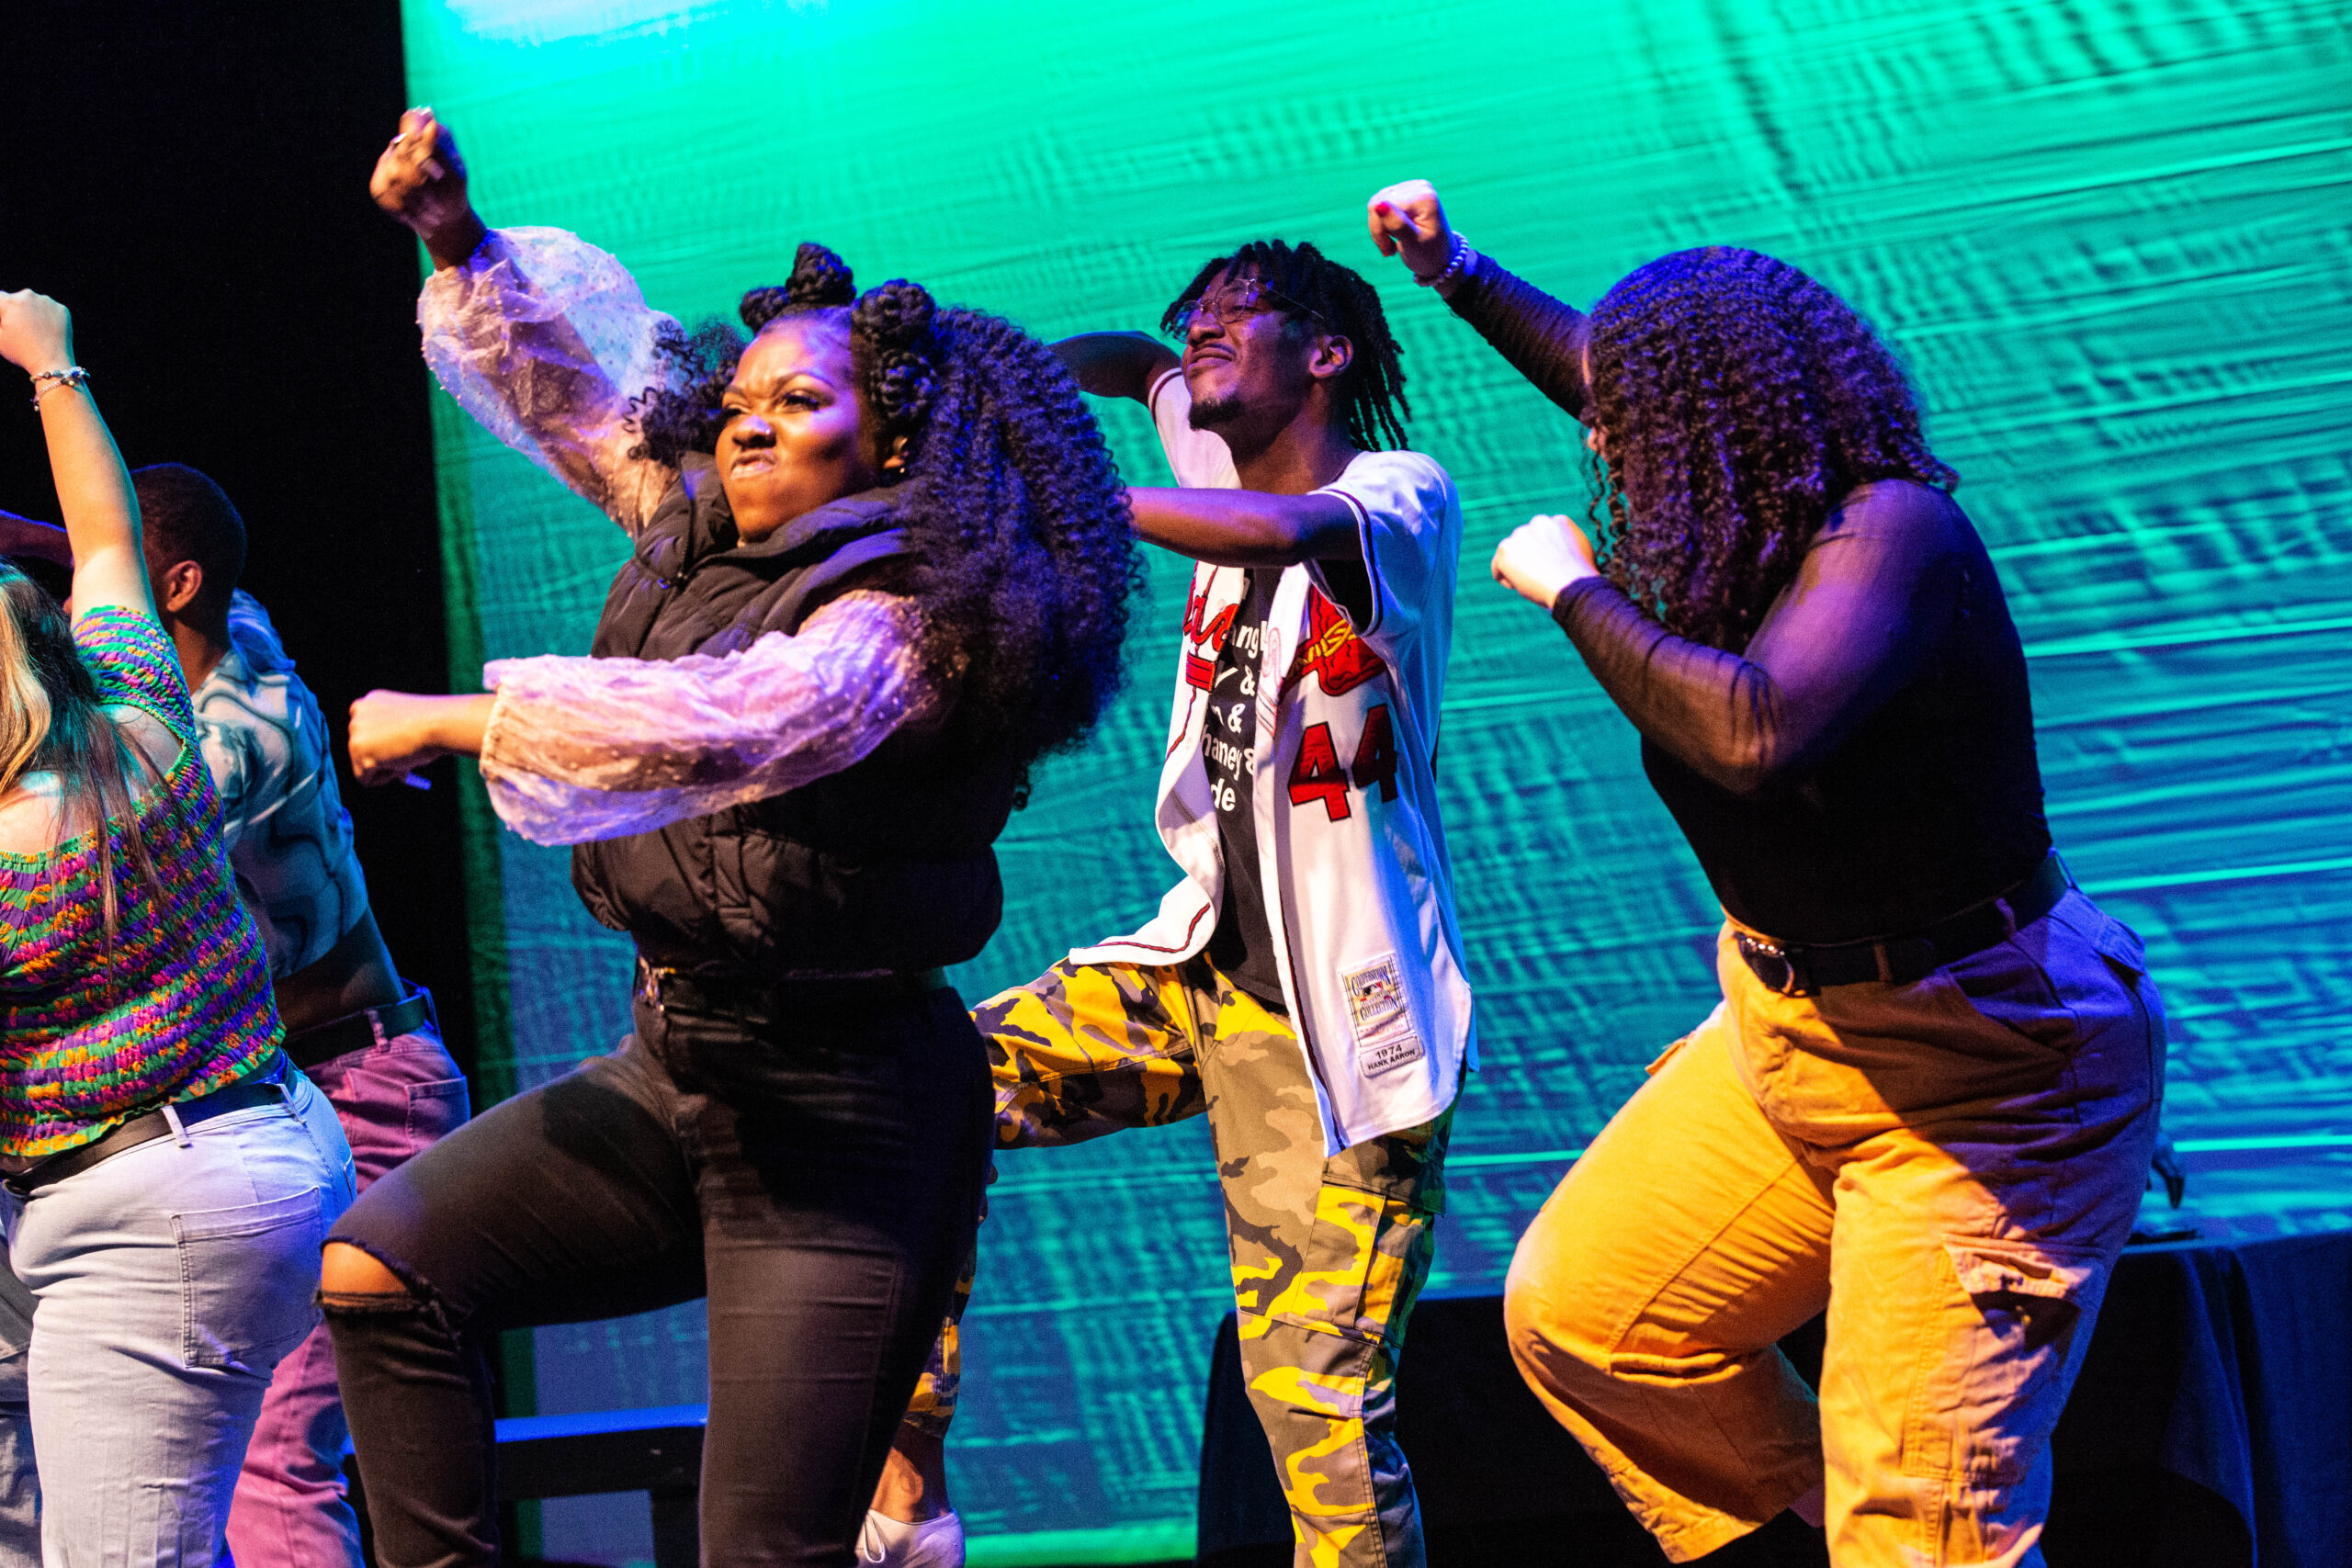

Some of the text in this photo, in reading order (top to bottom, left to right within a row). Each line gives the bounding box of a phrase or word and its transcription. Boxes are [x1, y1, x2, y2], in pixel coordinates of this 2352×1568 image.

[1240, 665, 1256, 697] &
[1227, 703, 1246, 734] &
[1287, 704, 1398, 823] 44
[1360, 995, 1399, 1021] COLLECTION
[1367, 1048, 1416, 1071] HANK AARON
[1375, 1043, 1403, 1059] 1974
